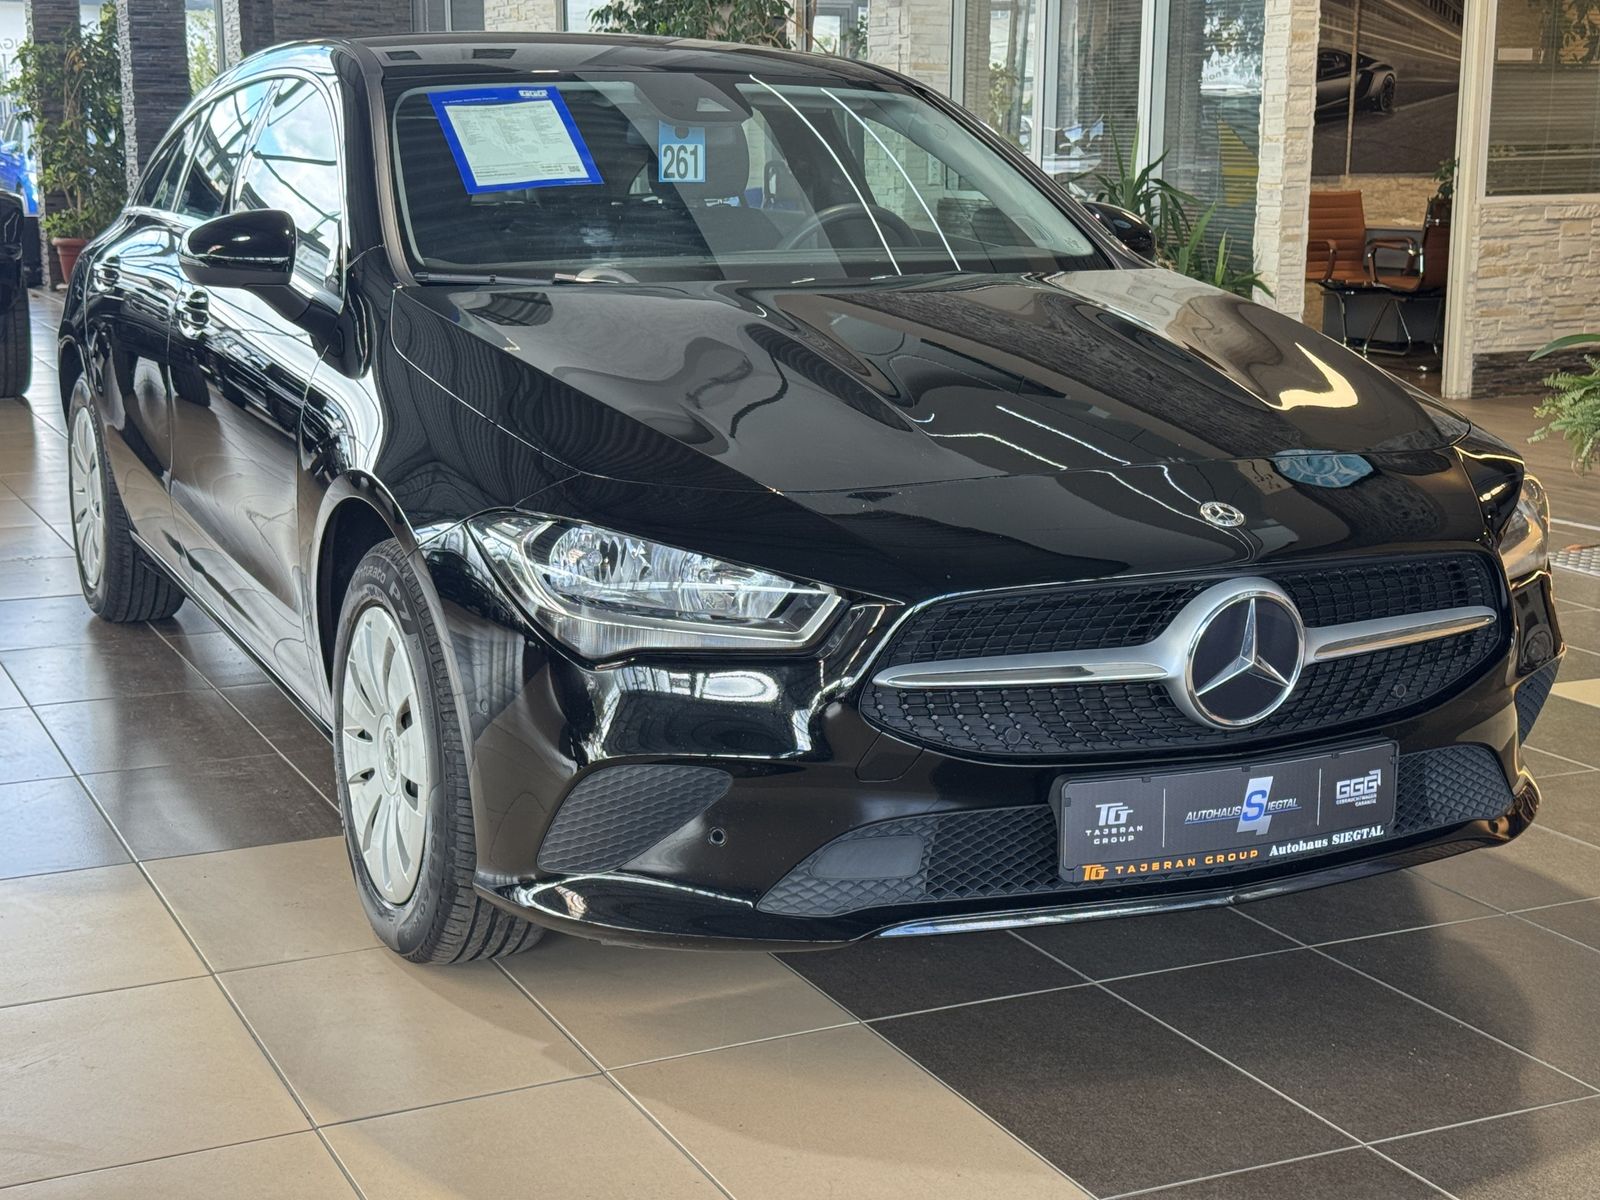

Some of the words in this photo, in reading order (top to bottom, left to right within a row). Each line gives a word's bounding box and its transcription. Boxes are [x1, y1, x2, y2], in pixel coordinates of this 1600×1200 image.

[663, 144, 698, 179] 261
[1336, 772, 1379, 800] GGG
[1095, 802, 1134, 826] TG
[1184, 806, 1242, 822] AUTOHAUS
[1085, 825, 1143, 837] TAJERAN
[1093, 835, 1135, 845] GROUP
[1081, 863, 1109, 881] TG
[1115, 857, 1197, 875] TAJERAN
[1204, 849, 1259, 865] GROUP
[1269, 838, 1329, 857] Autohaus
[1331, 825, 1384, 846] SIEGTAL
